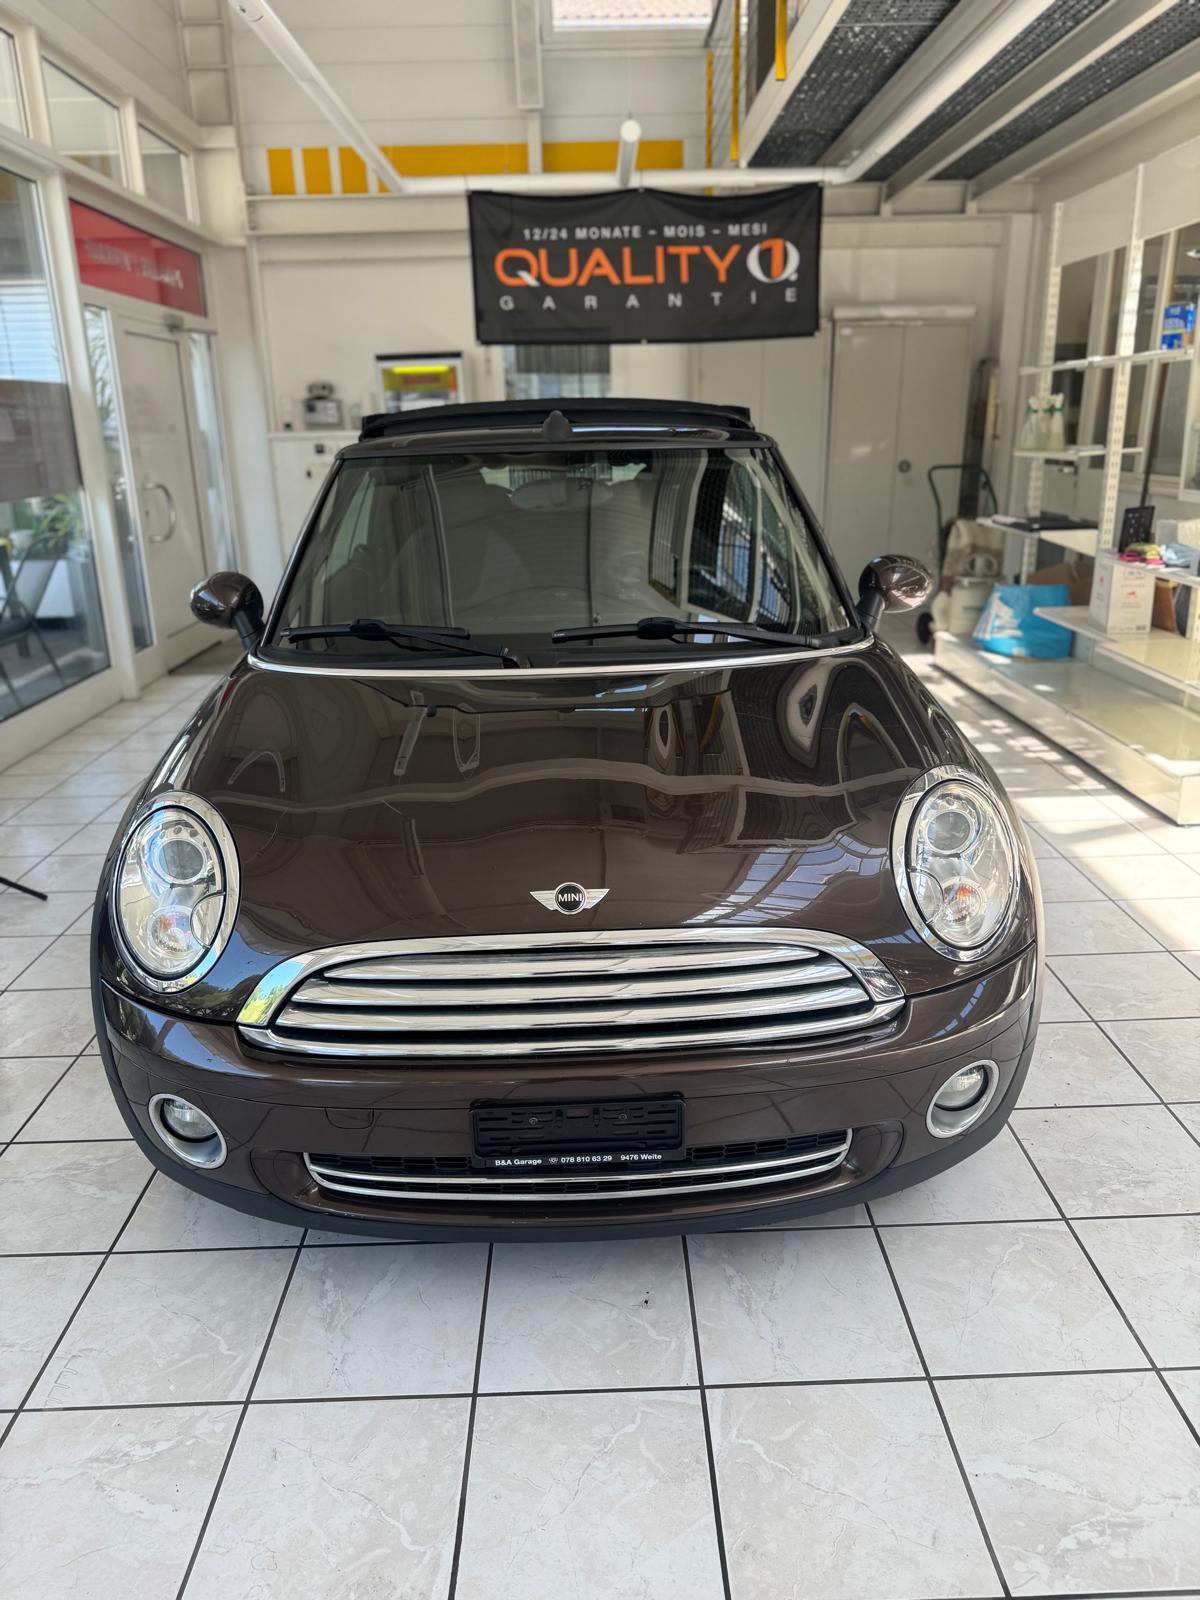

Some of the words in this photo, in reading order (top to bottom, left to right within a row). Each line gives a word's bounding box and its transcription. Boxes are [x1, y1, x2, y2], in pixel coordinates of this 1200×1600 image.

[523, 227, 568, 240] 12/24
[575, 225, 642, 240] MONATE
[663, 224, 705, 238] MOIS
[727, 223, 768, 236] MESI
[494, 243, 742, 287] QUALITY
[558, 893, 582, 902] MINI
[514, 1158, 542, 1166] Garage
